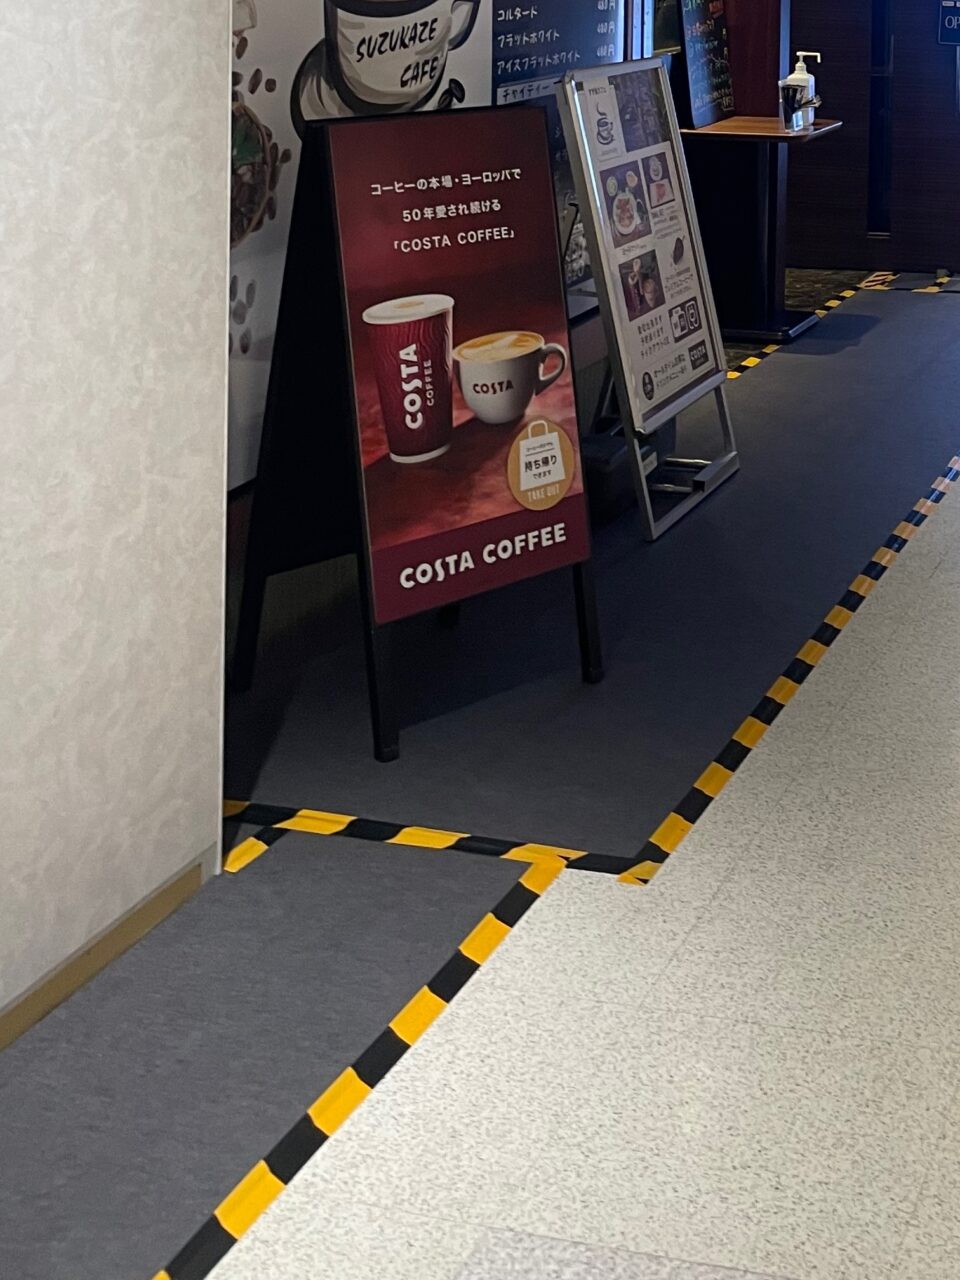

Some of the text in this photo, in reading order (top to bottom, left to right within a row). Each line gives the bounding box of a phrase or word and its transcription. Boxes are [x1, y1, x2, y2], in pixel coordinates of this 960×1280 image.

[497, 5, 538, 21] コルタード
[356, 18, 438, 63] SUZUKAZE
[497, 28, 560, 49] フラットホワイト
[400, 57, 439, 88] CAFE
[497, 50, 580, 75] アイスフラットホワイト
[371, 168, 522, 195] コーヒーの本場・ヨーロッパで
[402, 199, 501, 222] 50年愛され続ける
[400, 344, 423, 429] COSTA
[423, 359, 434, 406] COFFEE
[473, 380, 514, 395] COSTA
[524, 455, 557, 473] 持ち帰り
[399, 523, 567, 589] COSTA COFFEE
